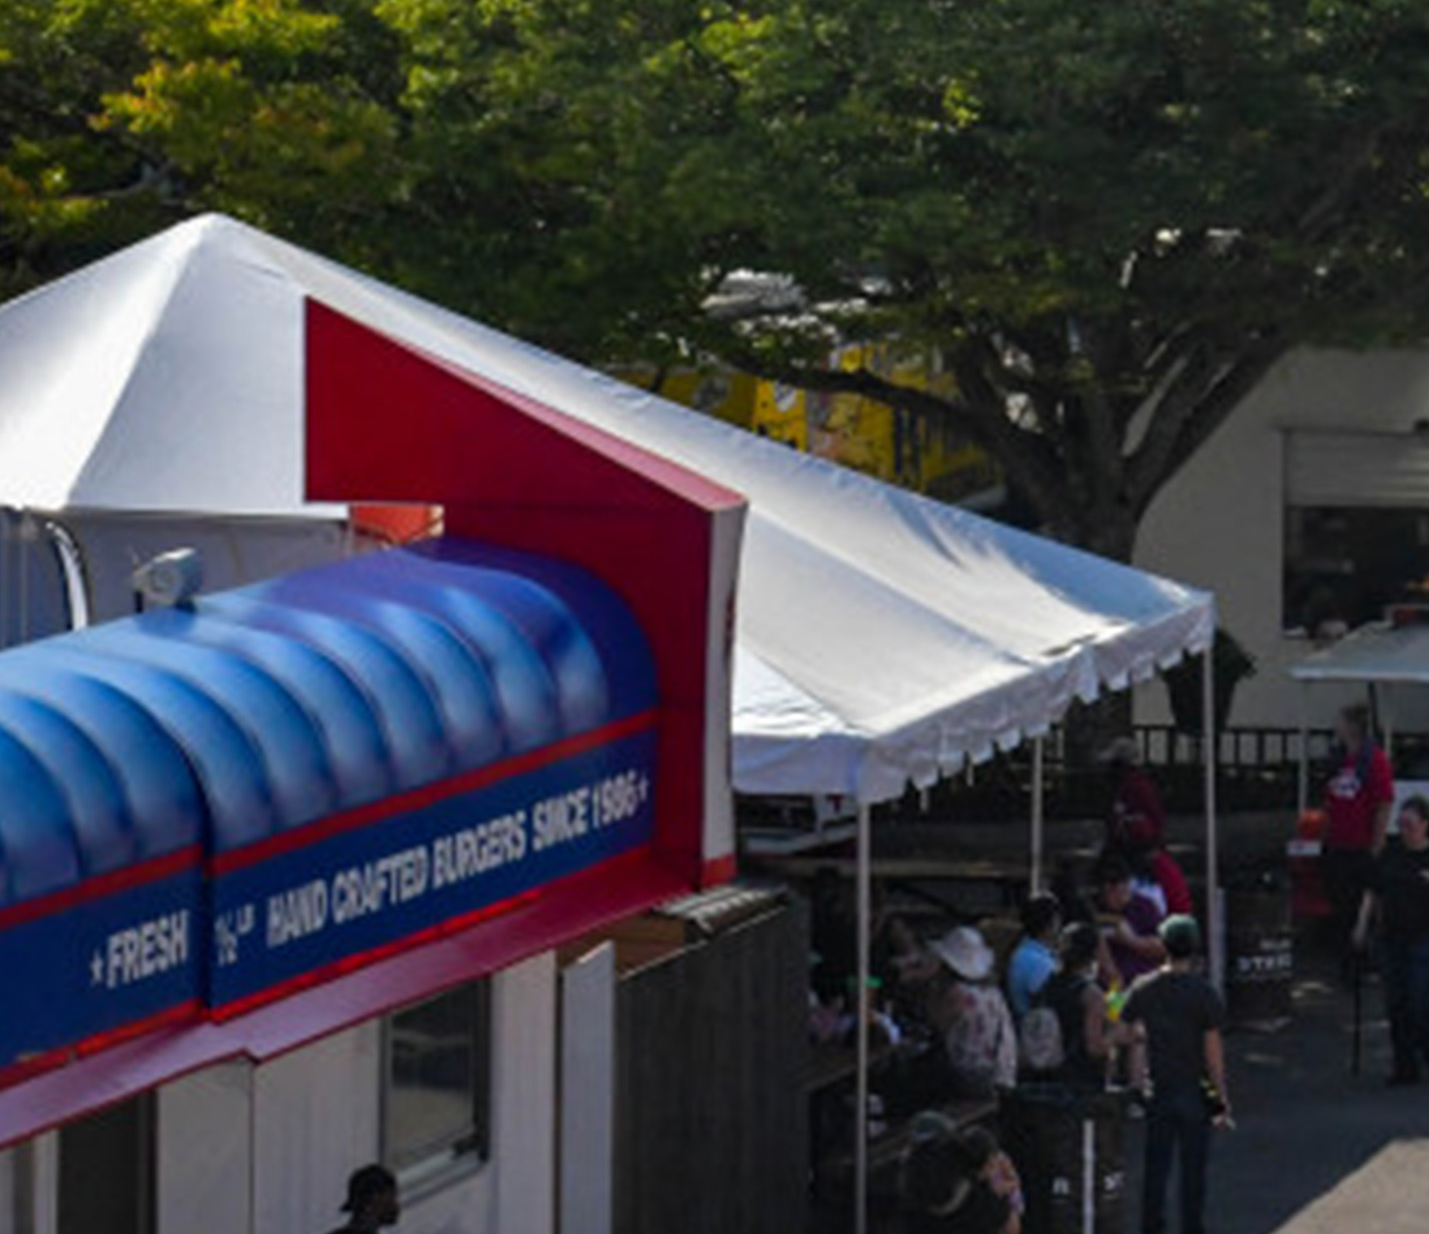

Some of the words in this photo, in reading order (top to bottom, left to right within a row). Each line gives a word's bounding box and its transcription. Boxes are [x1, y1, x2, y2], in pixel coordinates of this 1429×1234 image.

[107, 909, 188, 988] FRESH
[267, 879, 327, 947] HAND
[331, 845, 428, 923] CRAFTED
[432, 802, 526, 889] BURGERS
[532, 776, 589, 851] SINCE
